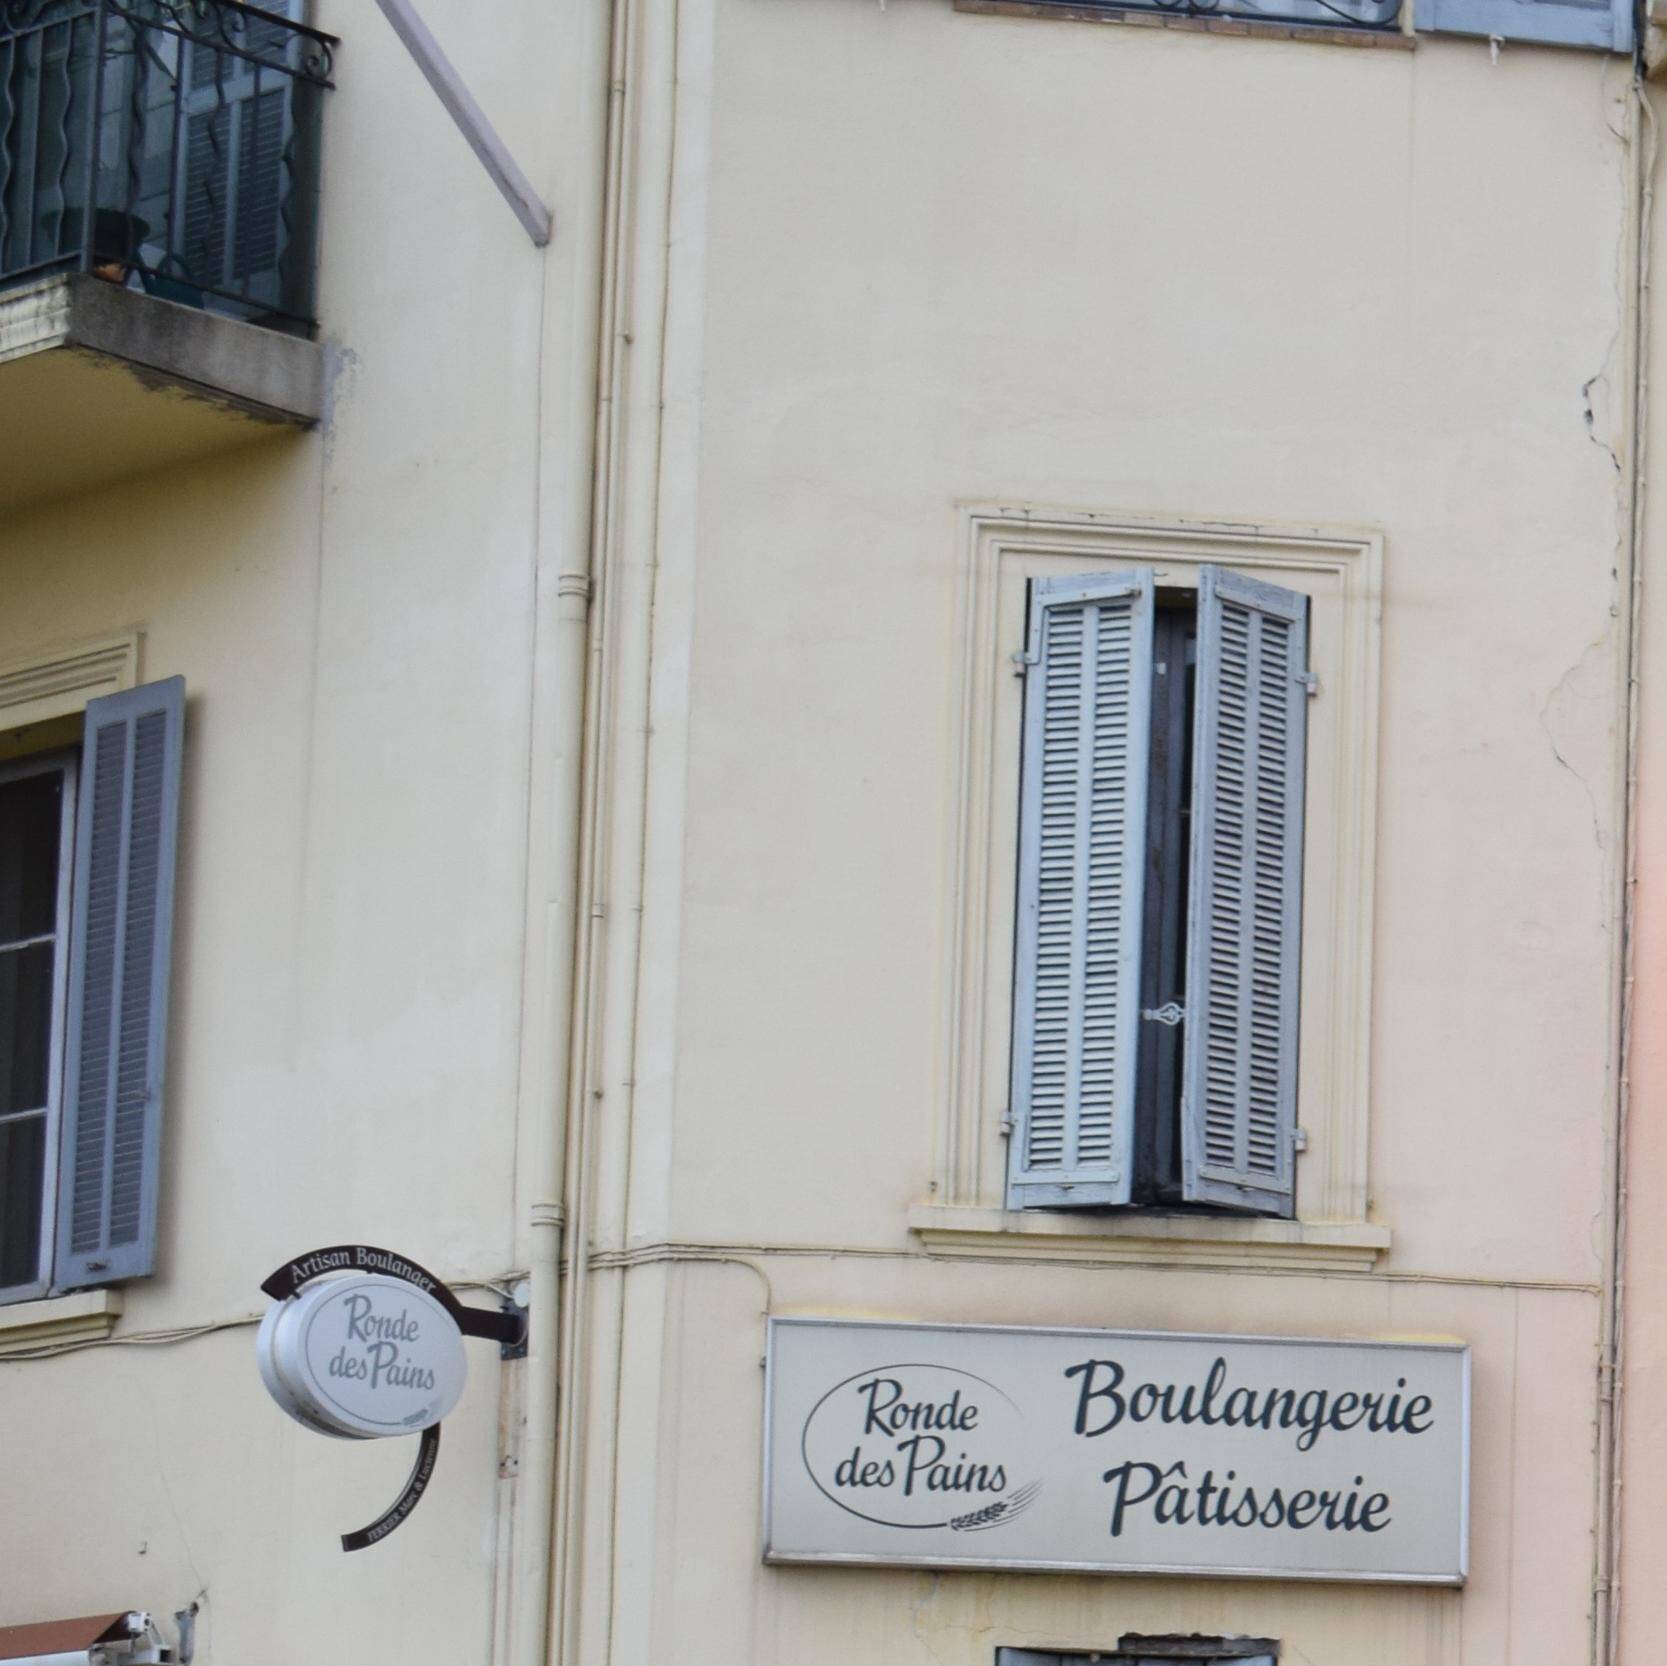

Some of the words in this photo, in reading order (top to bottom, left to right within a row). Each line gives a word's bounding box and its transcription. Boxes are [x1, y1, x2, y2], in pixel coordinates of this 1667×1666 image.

[291, 1250, 350, 1283] Artisan
[356, 1247, 437, 1293] Boulanger
[344, 1294, 420, 1342] Ronde
[329, 1346, 368, 1380] des
[367, 1341, 435, 1390] Pains
[857, 1378, 979, 1438] Ronde
[1064, 1356, 1434, 1452] Boulangerie
[835, 1445, 895, 1490] des
[895, 1436, 1007, 1498] Pains
[1103, 1460, 1393, 1538] Pâtisserie
